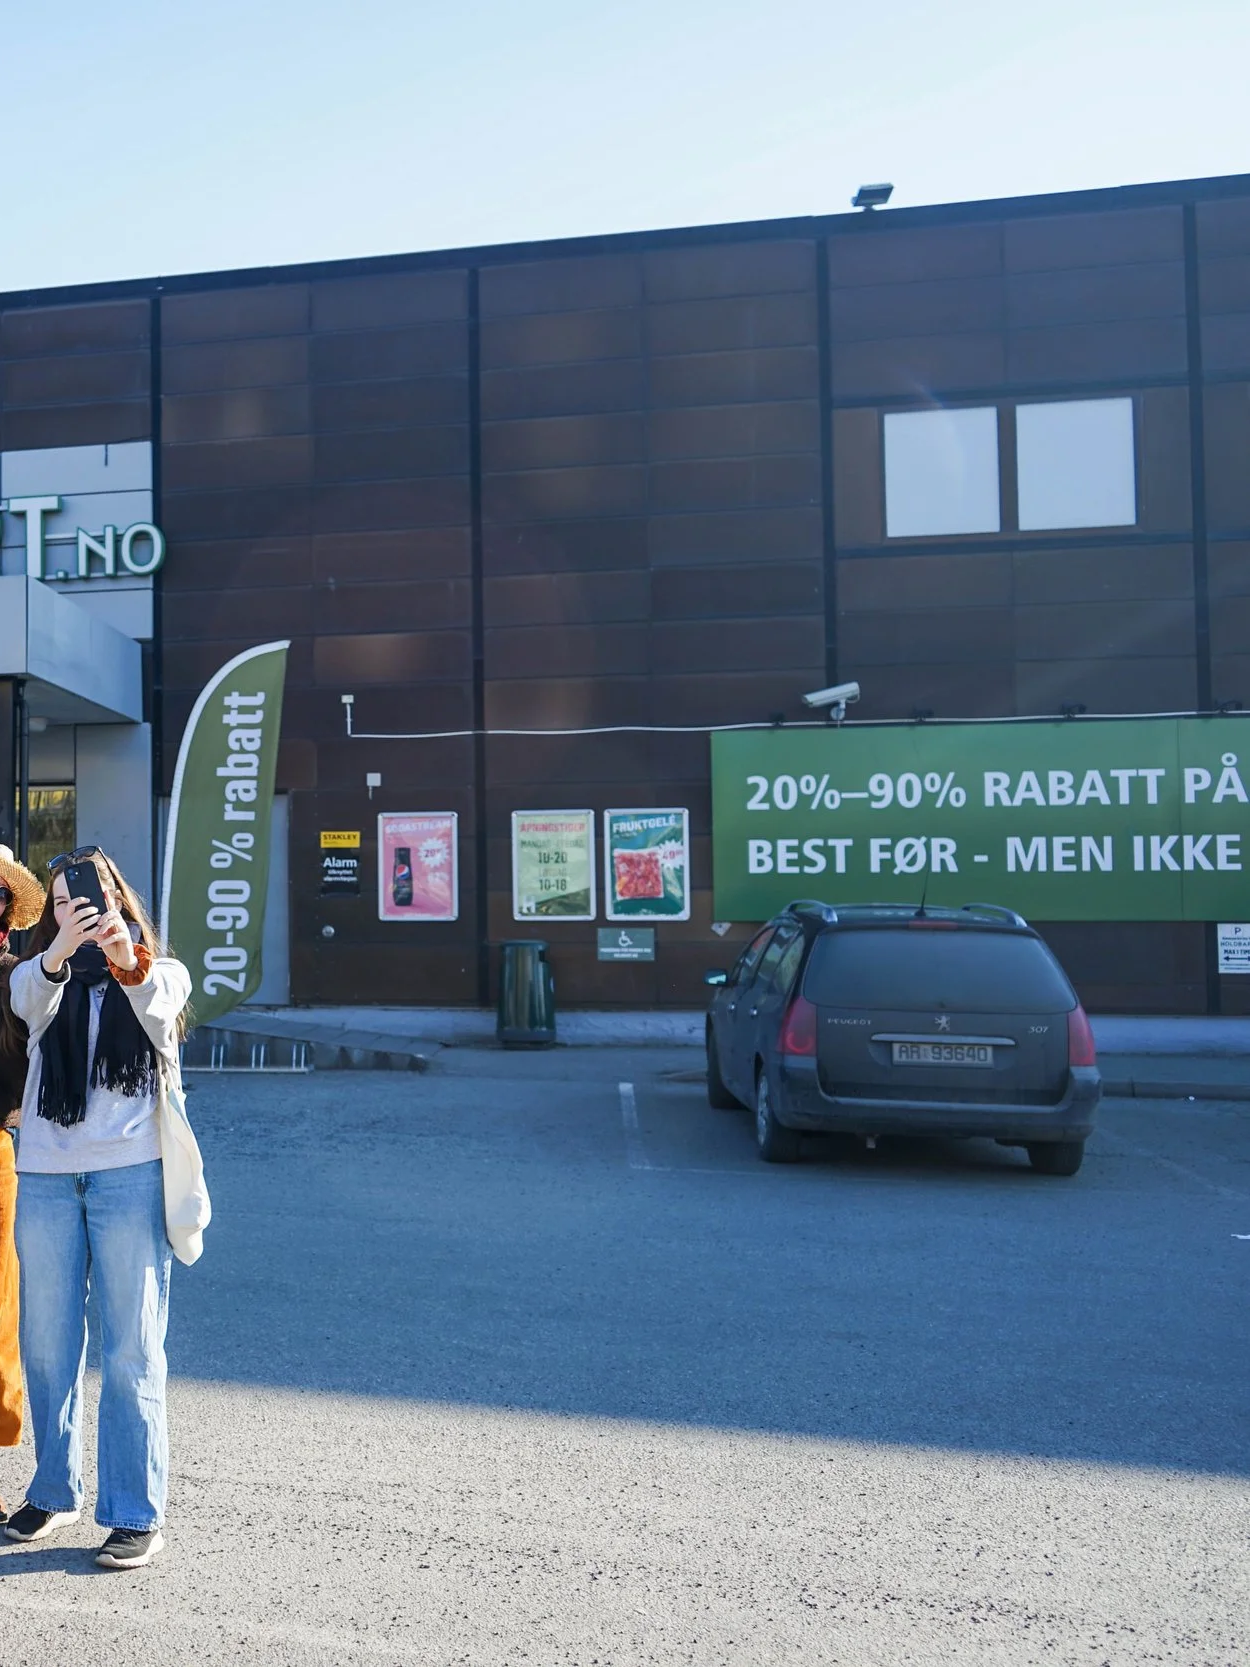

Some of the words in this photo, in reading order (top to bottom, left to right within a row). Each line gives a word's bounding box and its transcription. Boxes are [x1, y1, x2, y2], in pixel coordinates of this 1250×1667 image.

[216, 691, 266, 821] rabatt
[983, 768, 1166, 807] RABATT
[1183, 752, 1250, 804] PÅ
[323, 856, 358, 868] Alarm
[748, 838, 854, 875] BEST
[869, 836, 959, 875] FØR
[1006, 836, 1113, 873] MEN
[1133, 834, 1243, 872] IKKE
[202, 879, 251, 996] 20-90
